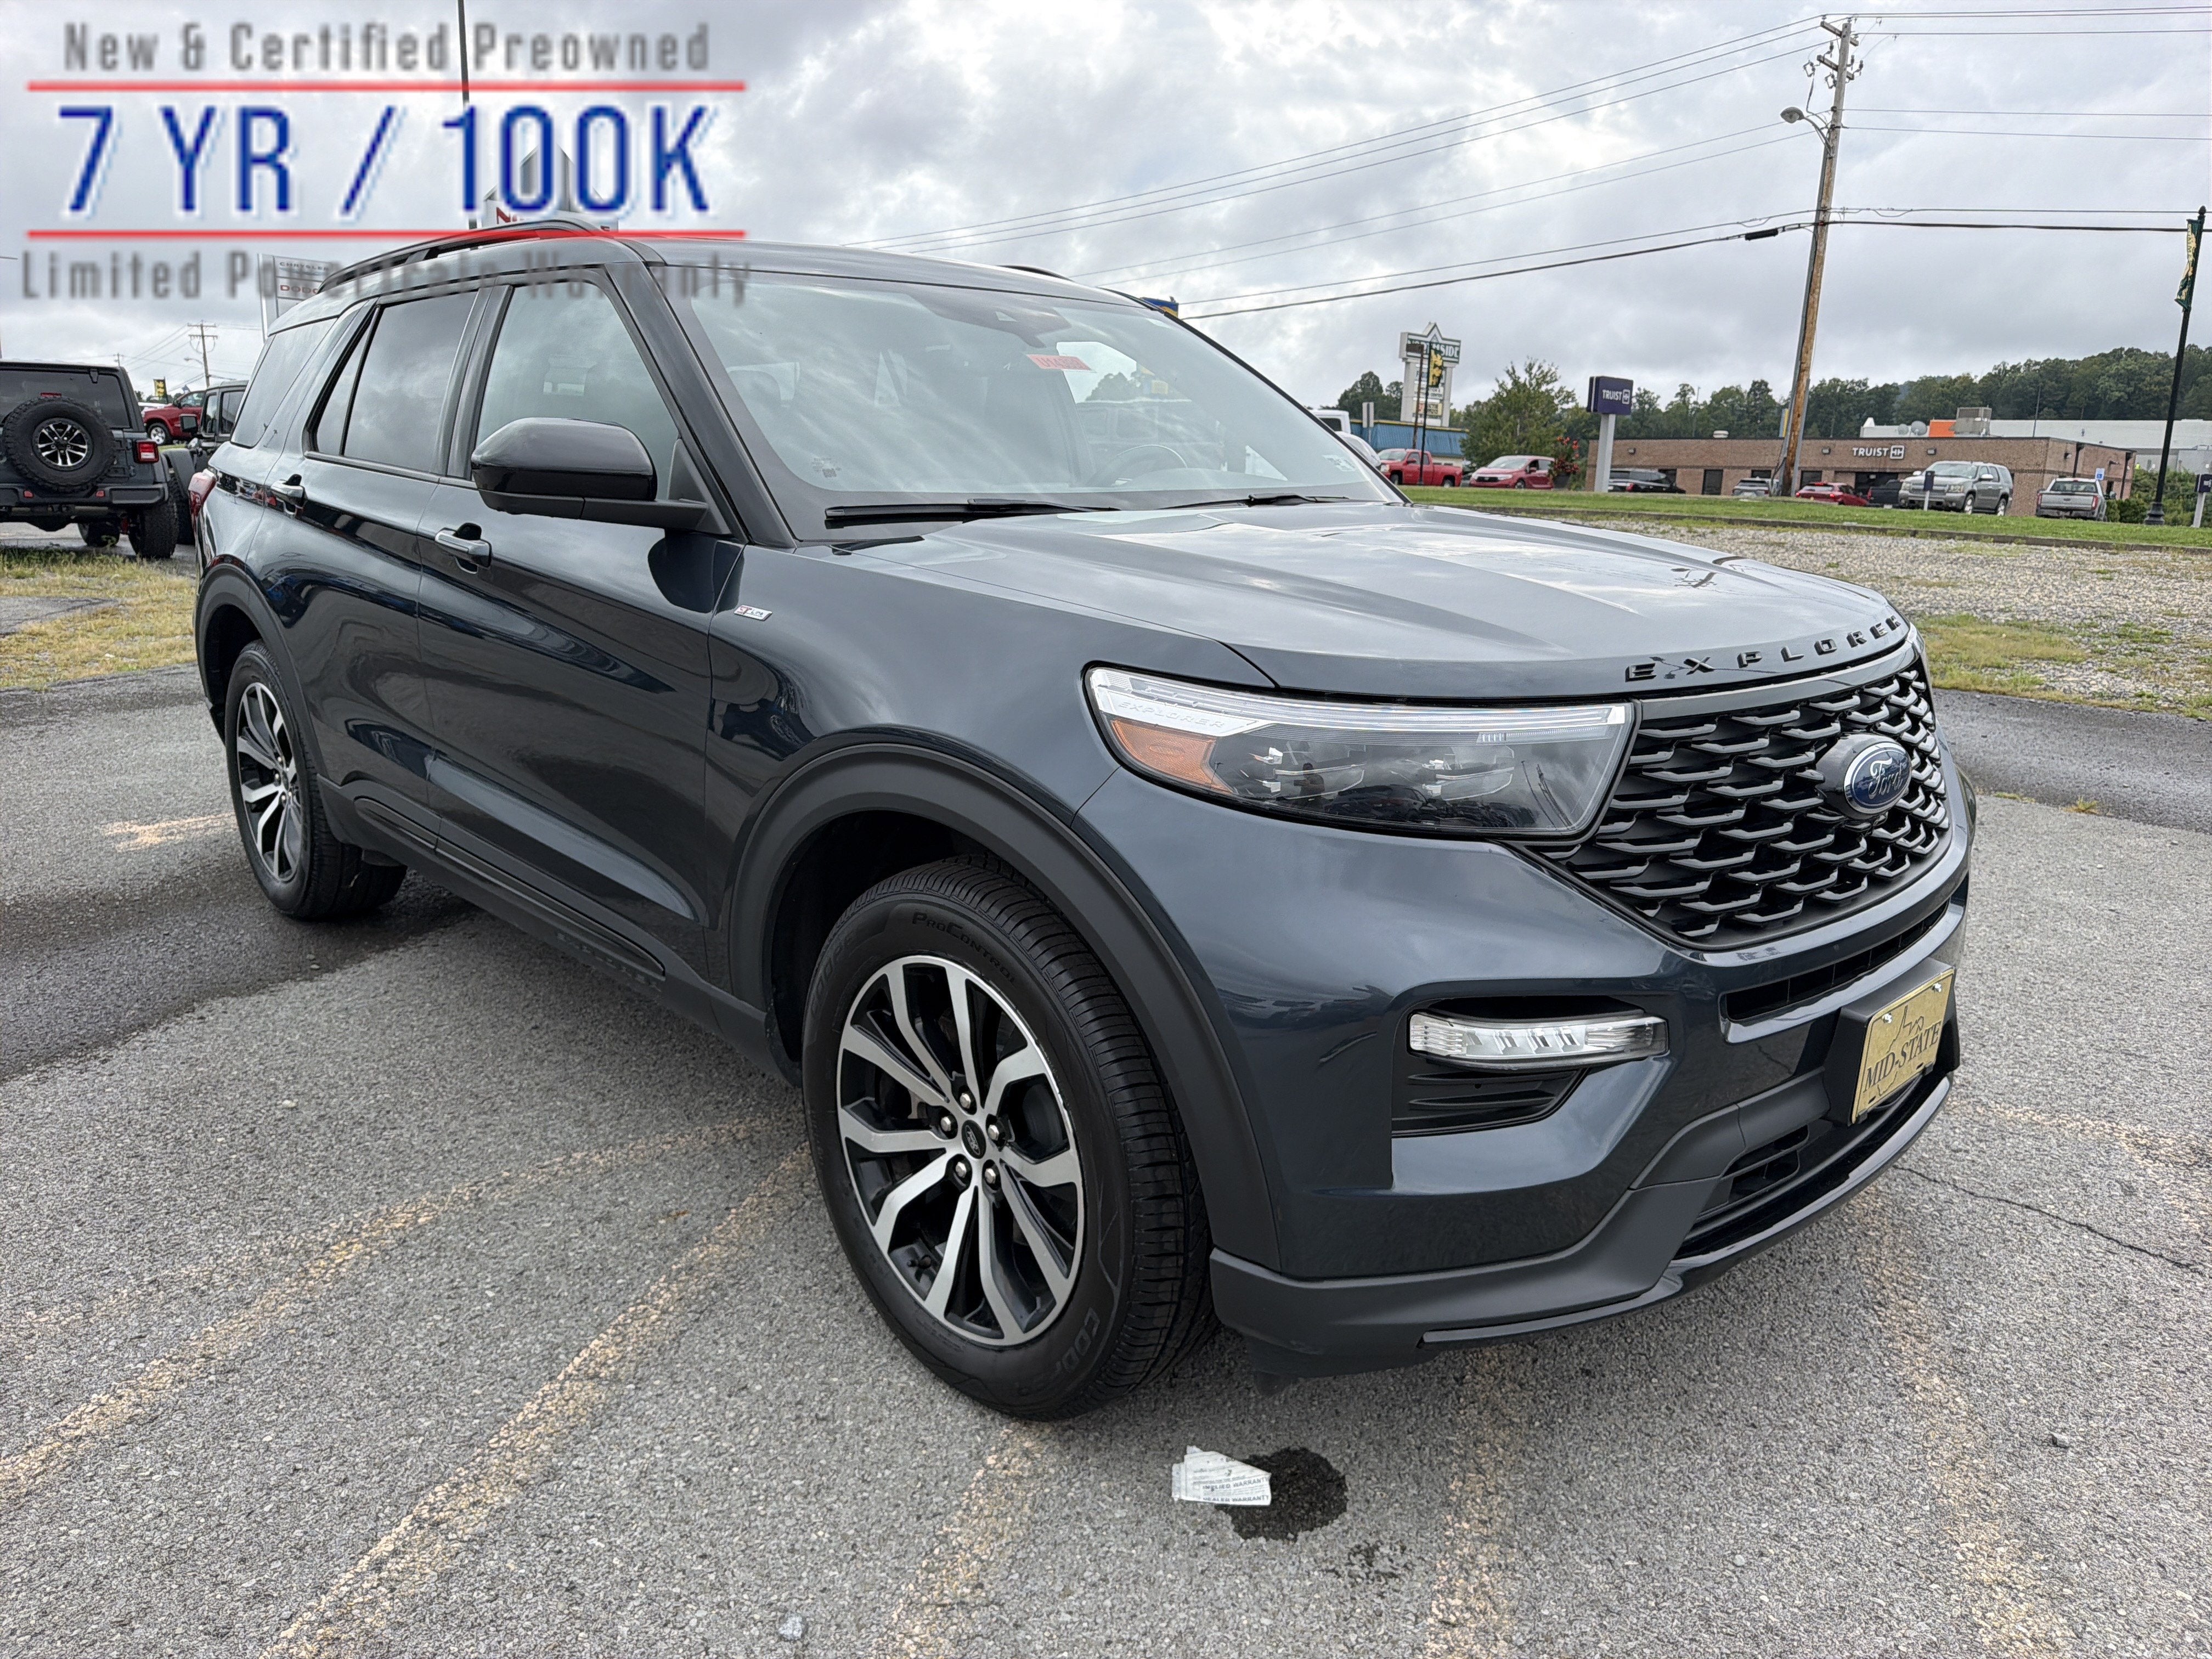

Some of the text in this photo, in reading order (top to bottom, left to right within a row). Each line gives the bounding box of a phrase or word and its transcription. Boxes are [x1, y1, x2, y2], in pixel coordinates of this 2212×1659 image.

[279, 262, 329, 271] CHRYSLER
[1602, 388, 1623, 401] TRUIST
[1852, 447, 1889, 457] TRUIST
[1624, 614, 1903, 683] EXPLORER
[1119, 701, 1226, 729] EXPLORER
[1867, 757, 1908, 800] Ford
[1863, 1020, 1942, 1093] MID-STATE
